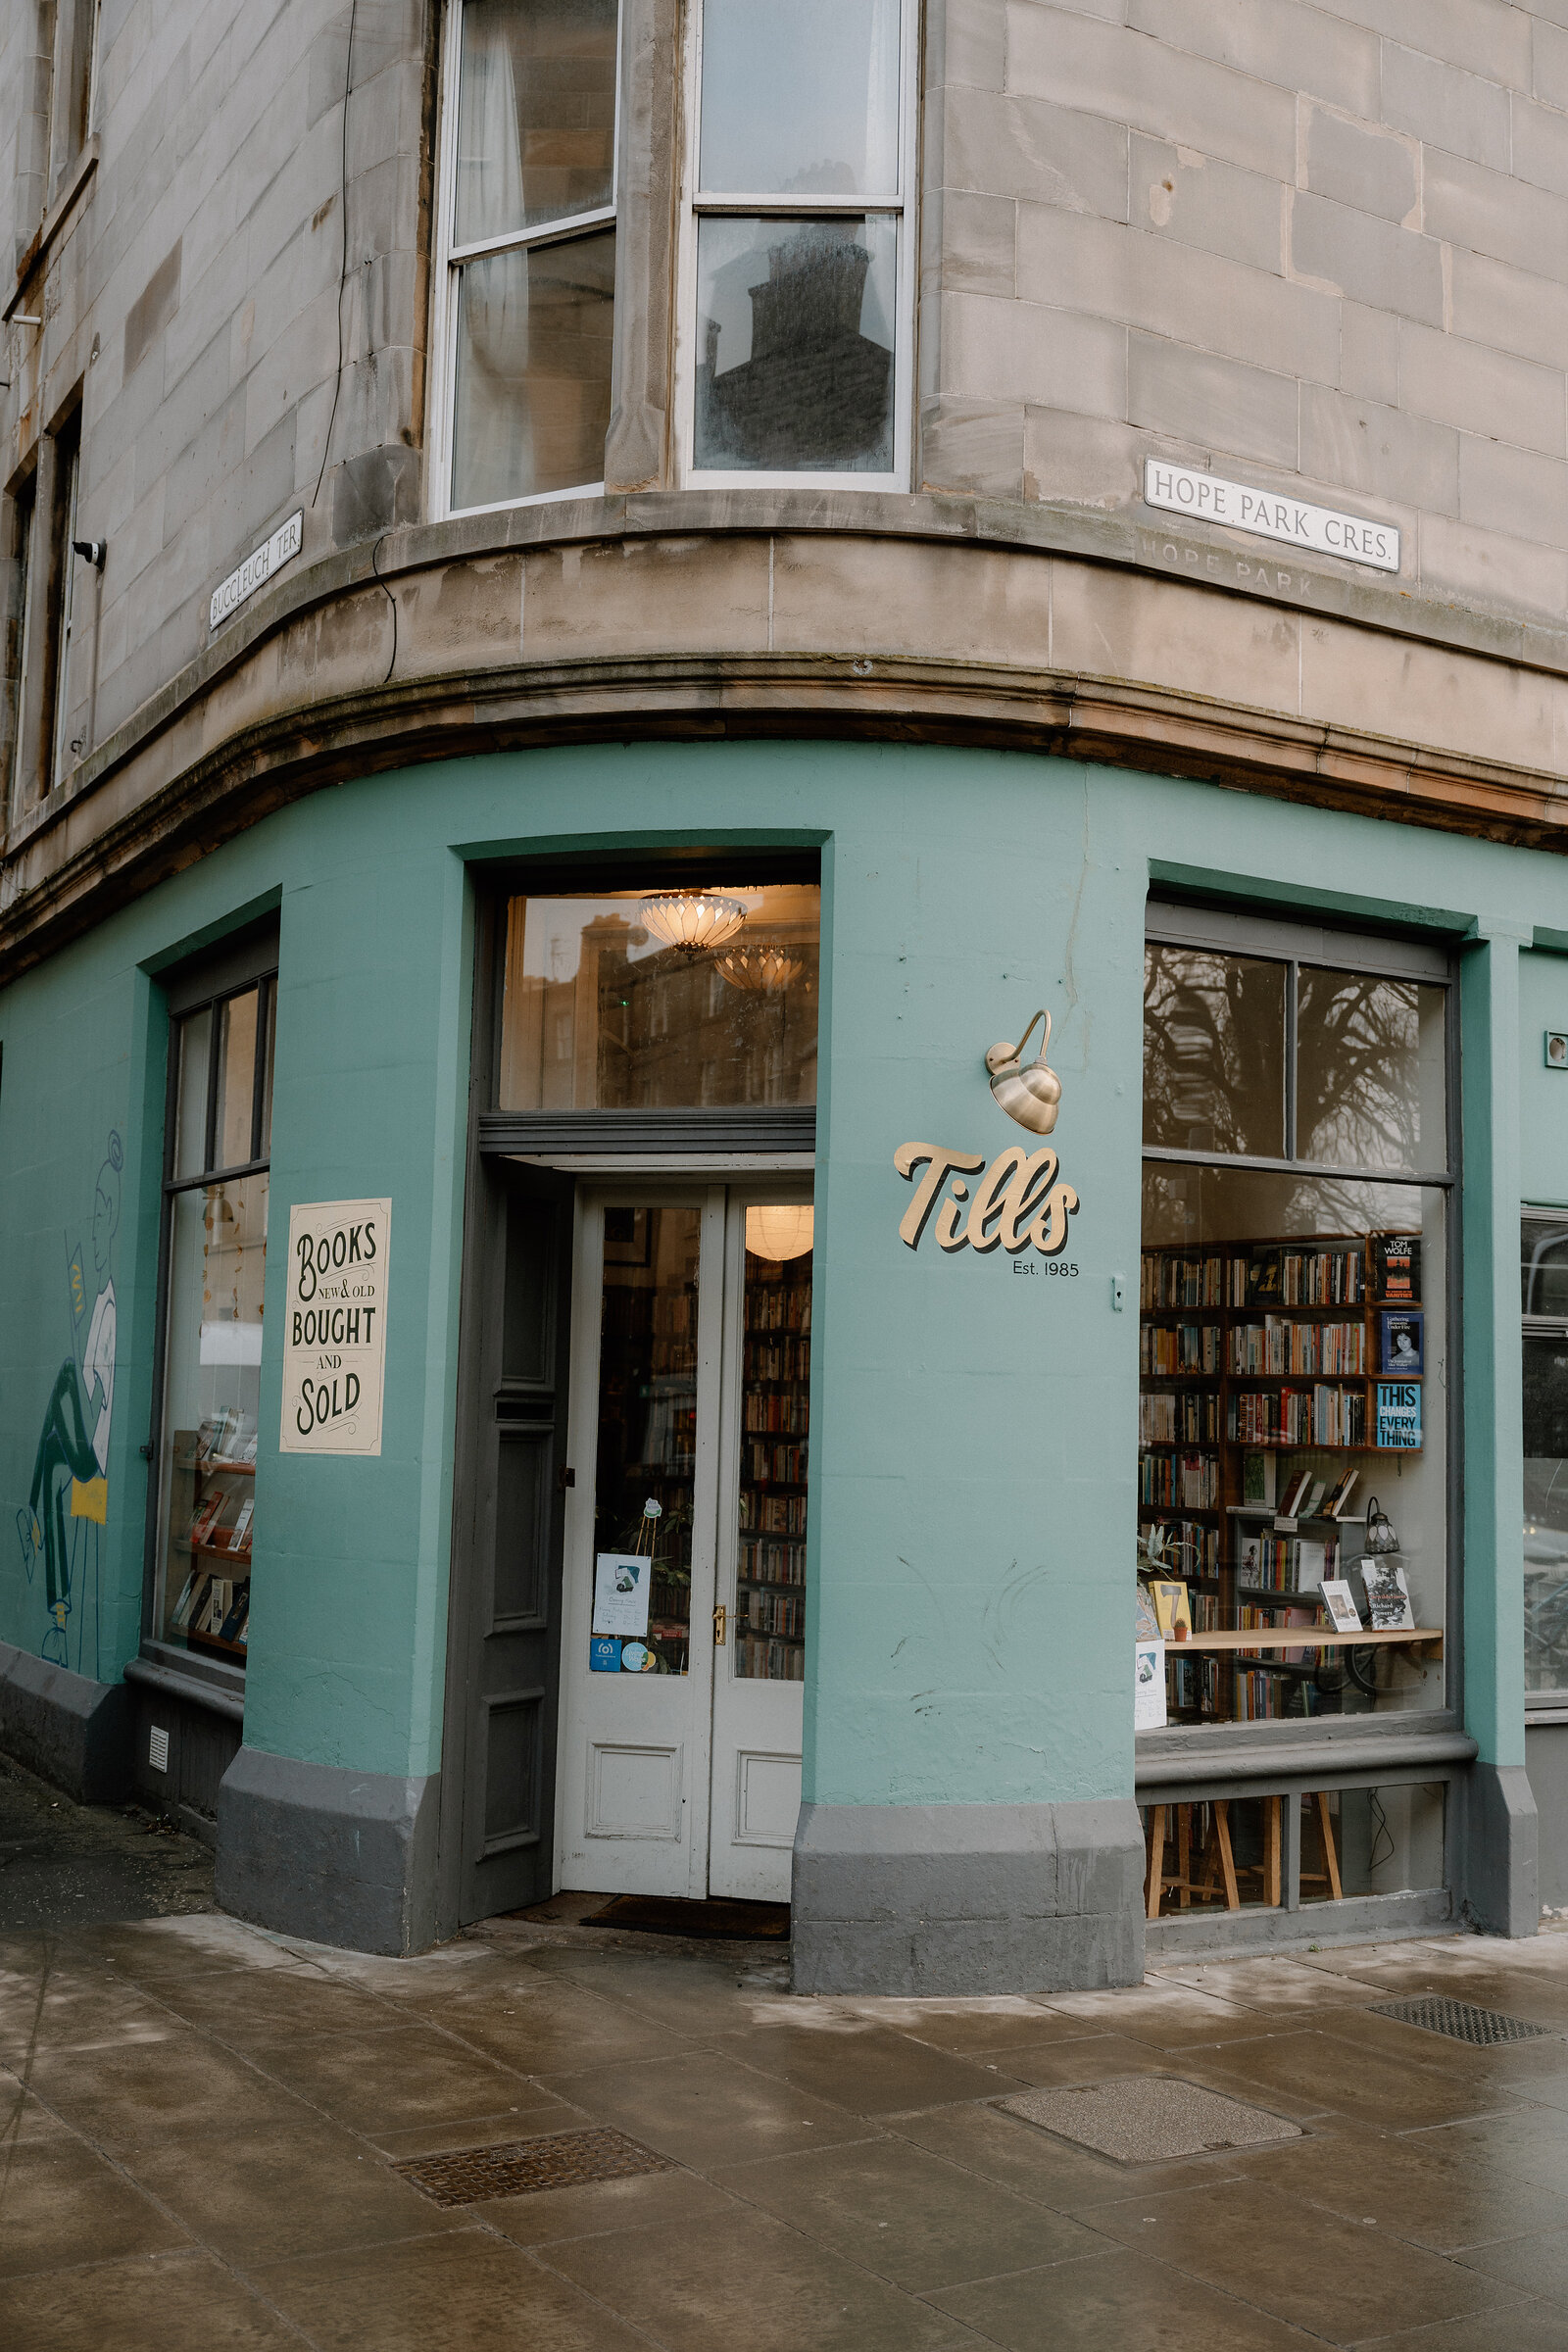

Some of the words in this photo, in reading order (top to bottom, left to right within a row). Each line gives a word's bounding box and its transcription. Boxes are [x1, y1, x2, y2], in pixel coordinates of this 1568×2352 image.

[1154, 469, 1226, 514] HOPE
[1241, 494, 1309, 538] PARK
[1324, 519, 1392, 561] CRES.
[212, 547, 270, 620] BUCCLEUCH
[1142, 540, 1220, 574] HOPE
[1236, 562, 1311, 598] PARK
[894, 1142, 1080, 1256] Tills
[297, 1222, 376, 1302] BOOKS
[1012, 1260, 1039, 1275] Est.
[1045, 1262, 1079, 1277] 1985
[318, 1286, 340, 1299] NEW
[340, 1278, 350, 1298] &
[352, 1284, 375, 1298] OLD
[292, 1306, 376, 1347] BOUGHT
[316, 1354, 342, 1370] AND
[296, 1372, 361, 1436] SOLD
[1380, 1386, 1416, 1406] THIS
[1380, 1405, 1417, 1417] CHANGES
[1380, 1416, 1416, 1430] EVERY
[1380, 1430, 1416, 1446] THING
